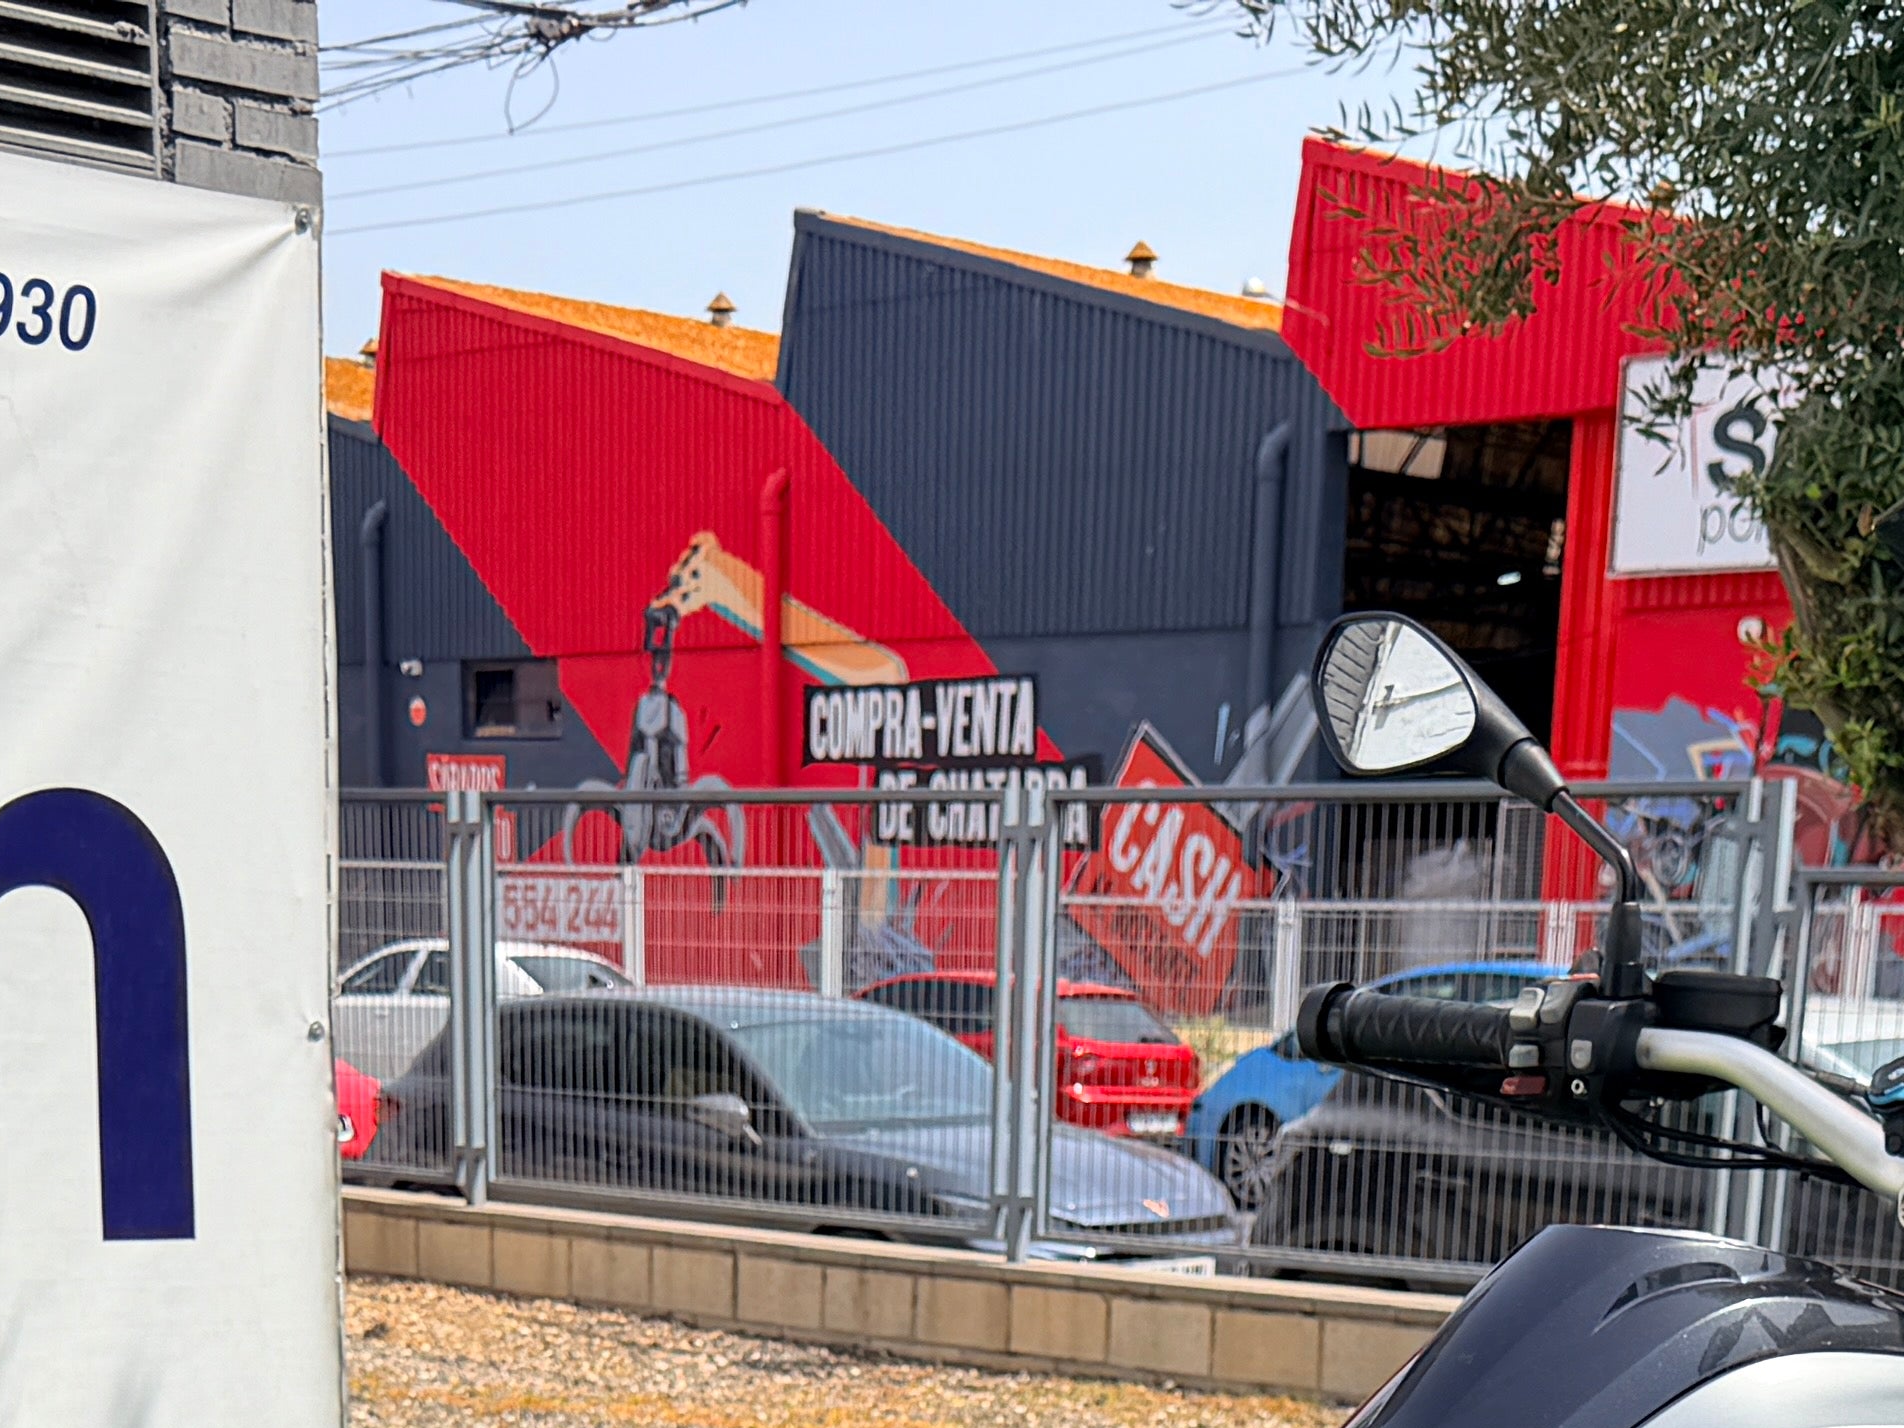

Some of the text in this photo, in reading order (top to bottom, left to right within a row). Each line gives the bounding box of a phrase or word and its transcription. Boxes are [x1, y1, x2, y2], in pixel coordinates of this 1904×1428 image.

[809, 677, 1035, 760] COMPRA-VENTA
[879, 765, 1090, 844] DE CHATA
[1109, 778, 1243, 957] CASH
